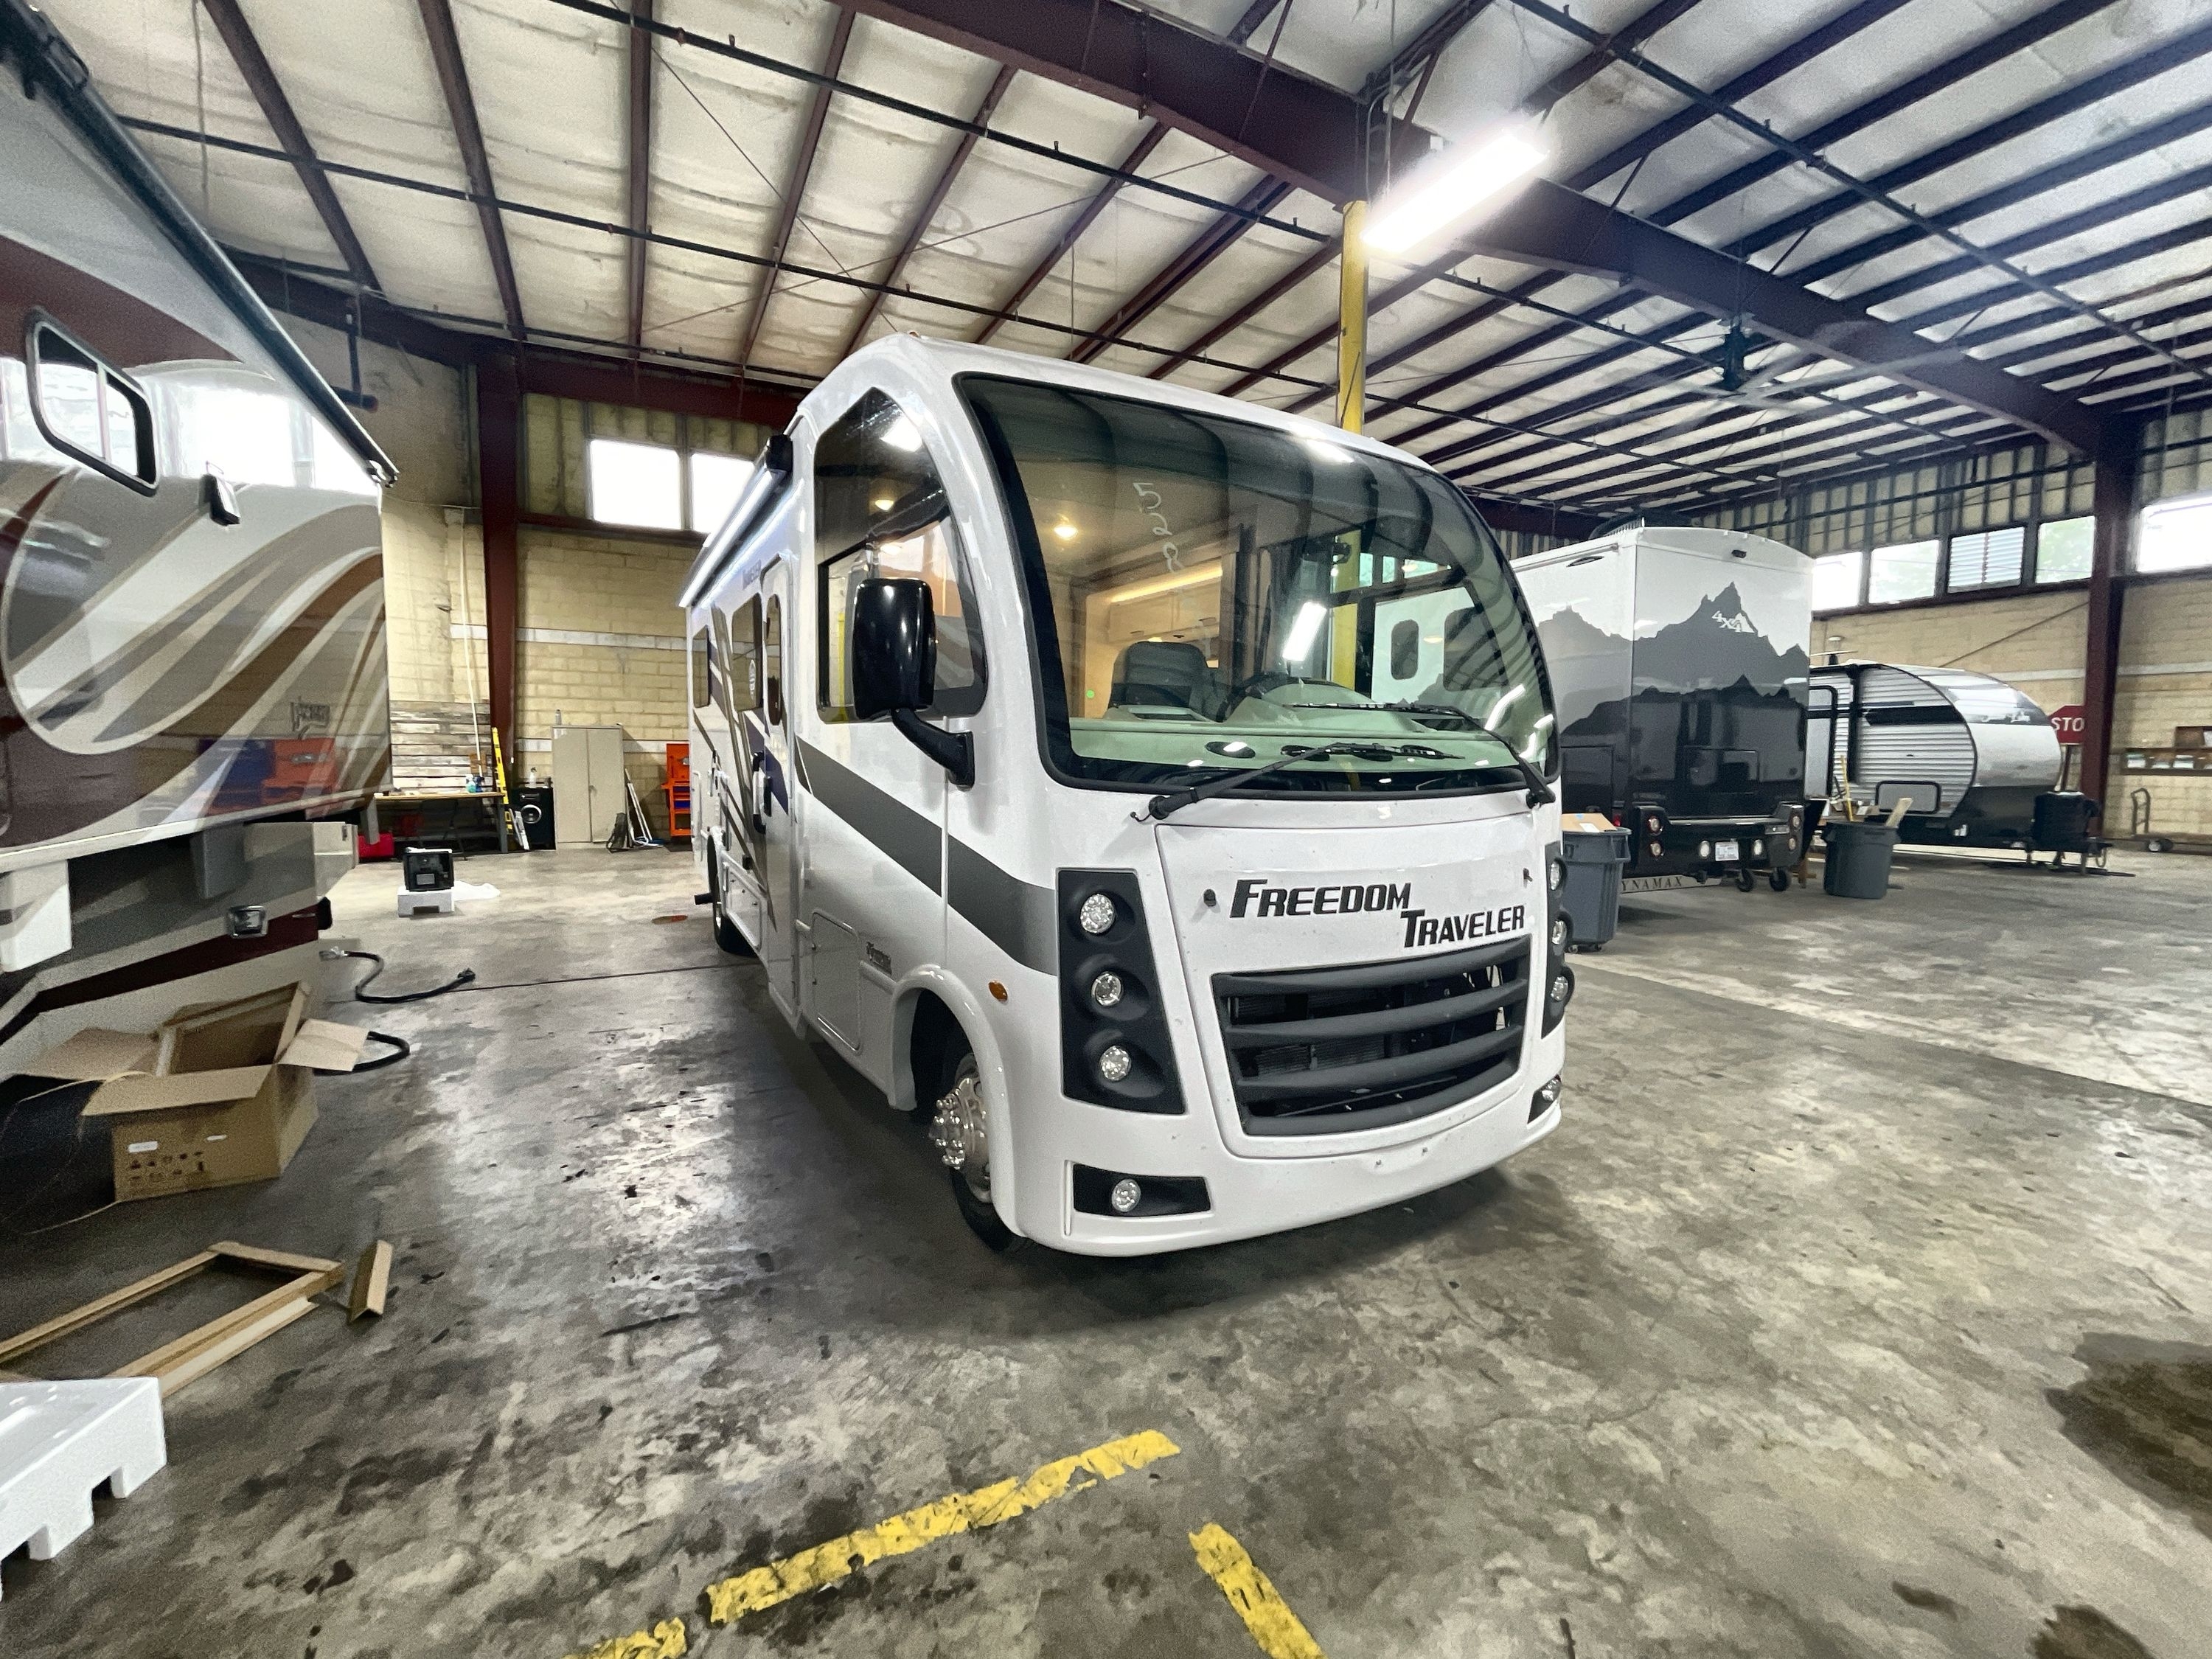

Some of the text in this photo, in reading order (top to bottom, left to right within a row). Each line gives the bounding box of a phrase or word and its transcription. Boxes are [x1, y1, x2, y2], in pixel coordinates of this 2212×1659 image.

[2051, 717, 2084, 731] STO
[1621, 875, 1683, 891] YNAMAX
[1230, 879, 1411, 919] FREEDOM
[1400, 905, 1525, 948] TRAVELER
